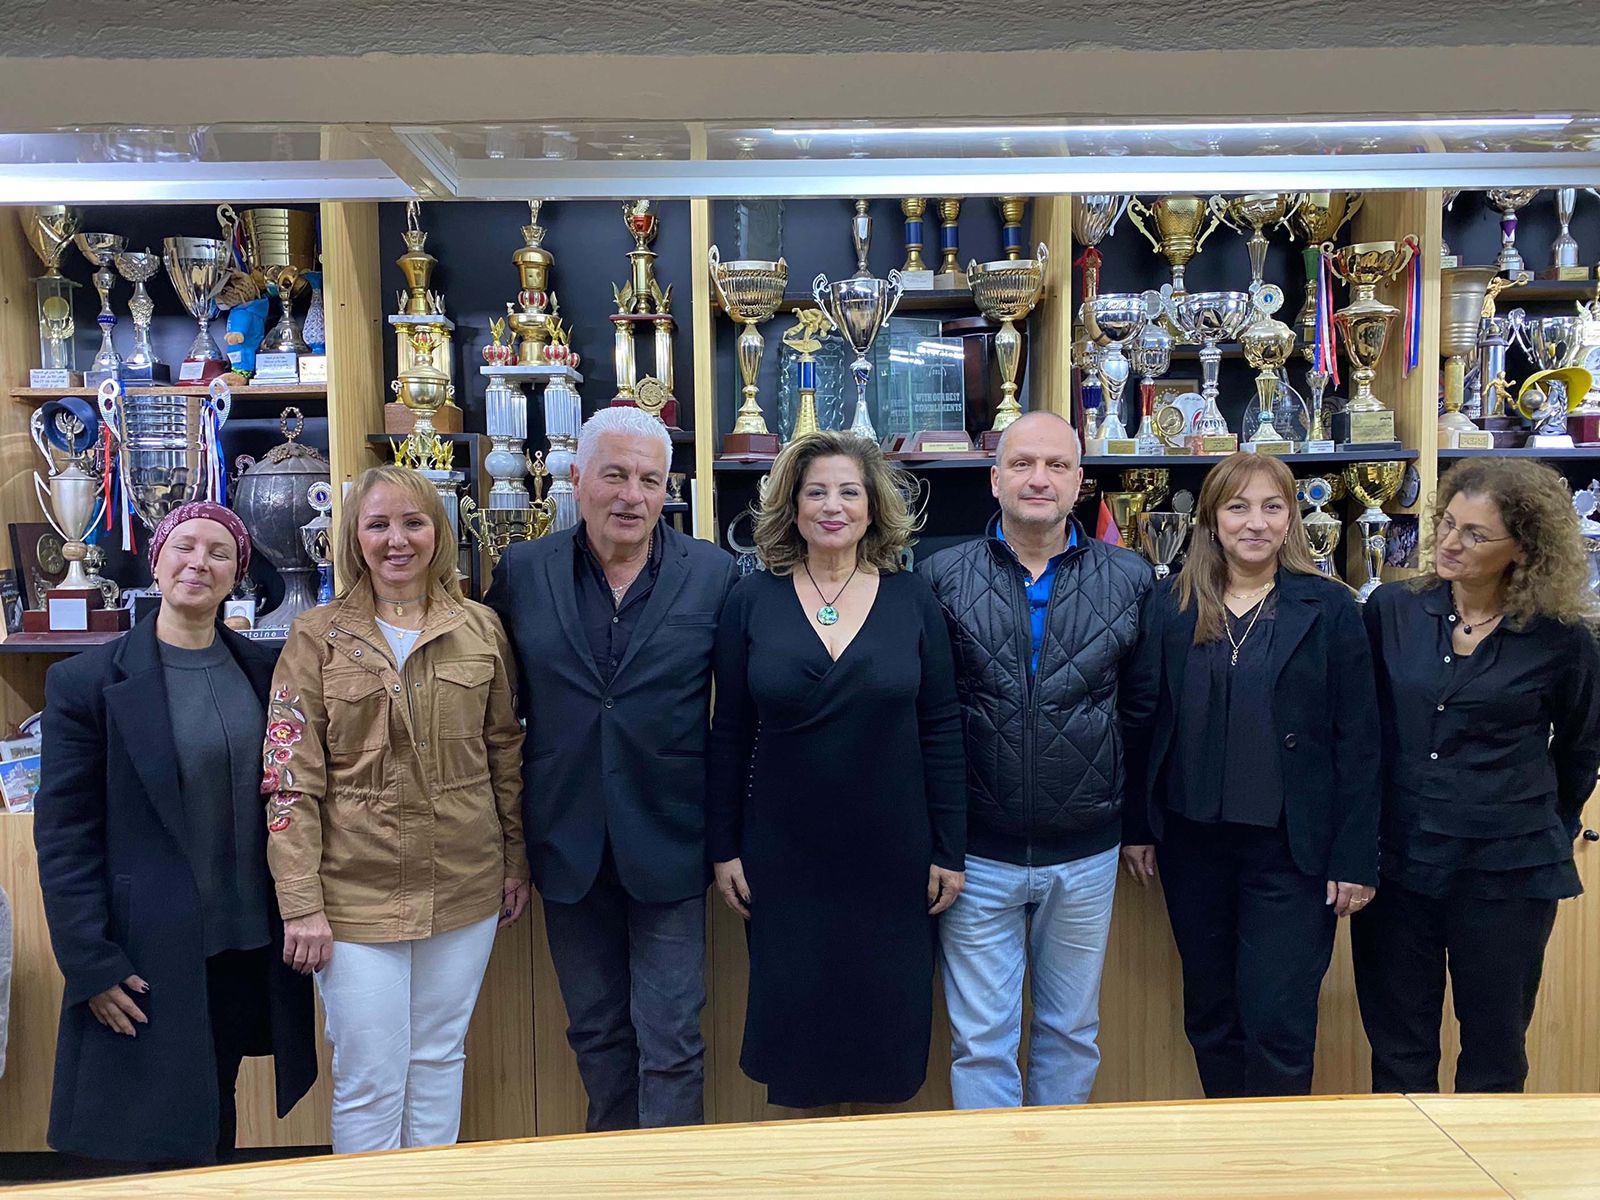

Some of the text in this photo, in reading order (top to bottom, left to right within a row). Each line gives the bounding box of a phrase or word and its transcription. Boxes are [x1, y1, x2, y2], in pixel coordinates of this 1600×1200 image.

[915, 392, 960, 402] WITH OUR BEST
[914, 403, 962, 412] COMPLIMENTS
[242, 630, 277, 638] ntoine
